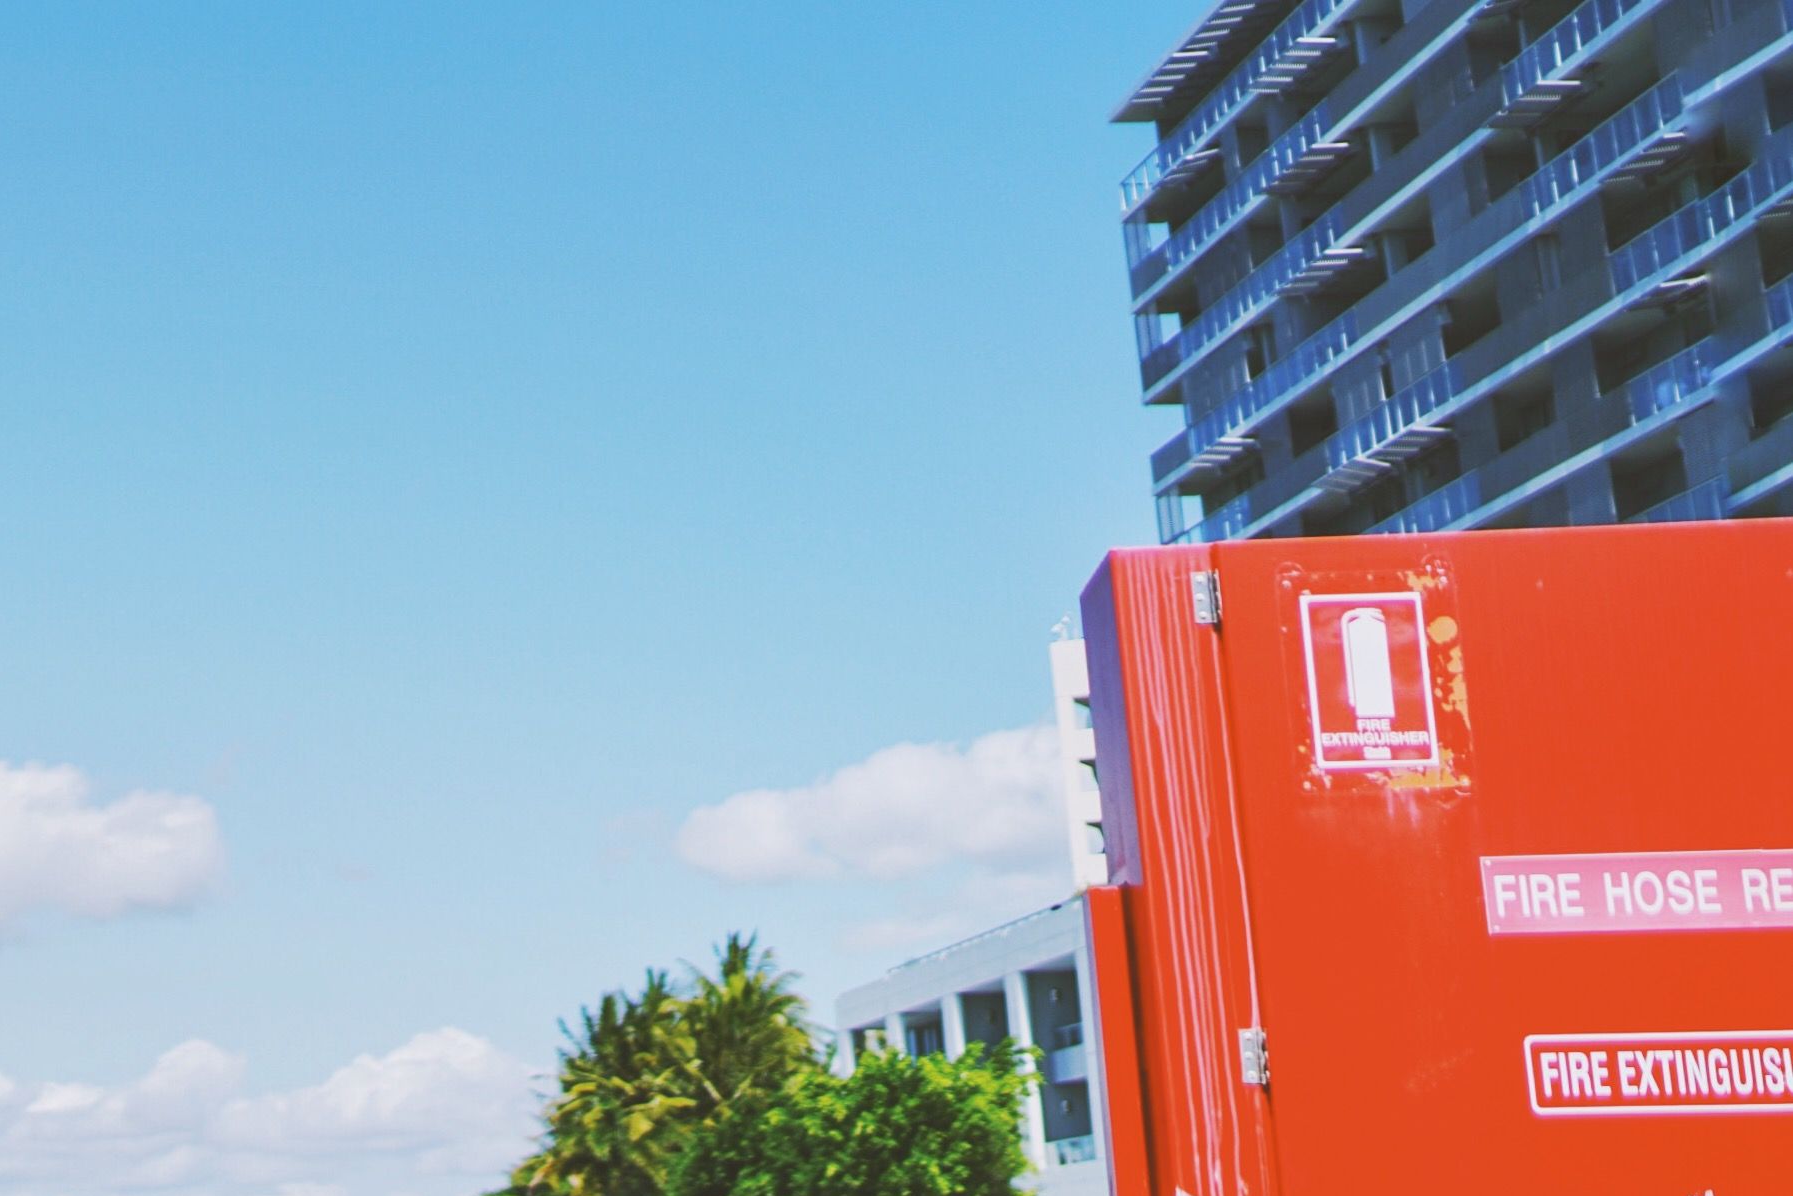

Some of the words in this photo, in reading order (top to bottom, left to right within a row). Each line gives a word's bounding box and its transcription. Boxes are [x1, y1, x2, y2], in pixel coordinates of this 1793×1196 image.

[1321, 731, 1430, 746] EXTINGUISHER
[1357, 719, 1390, 731] FIRE
[1493, 873, 1585, 918] FIRE
[1603, 870, 1722, 917] HOSE
[1540, 1051, 1612, 1098] FIRE
